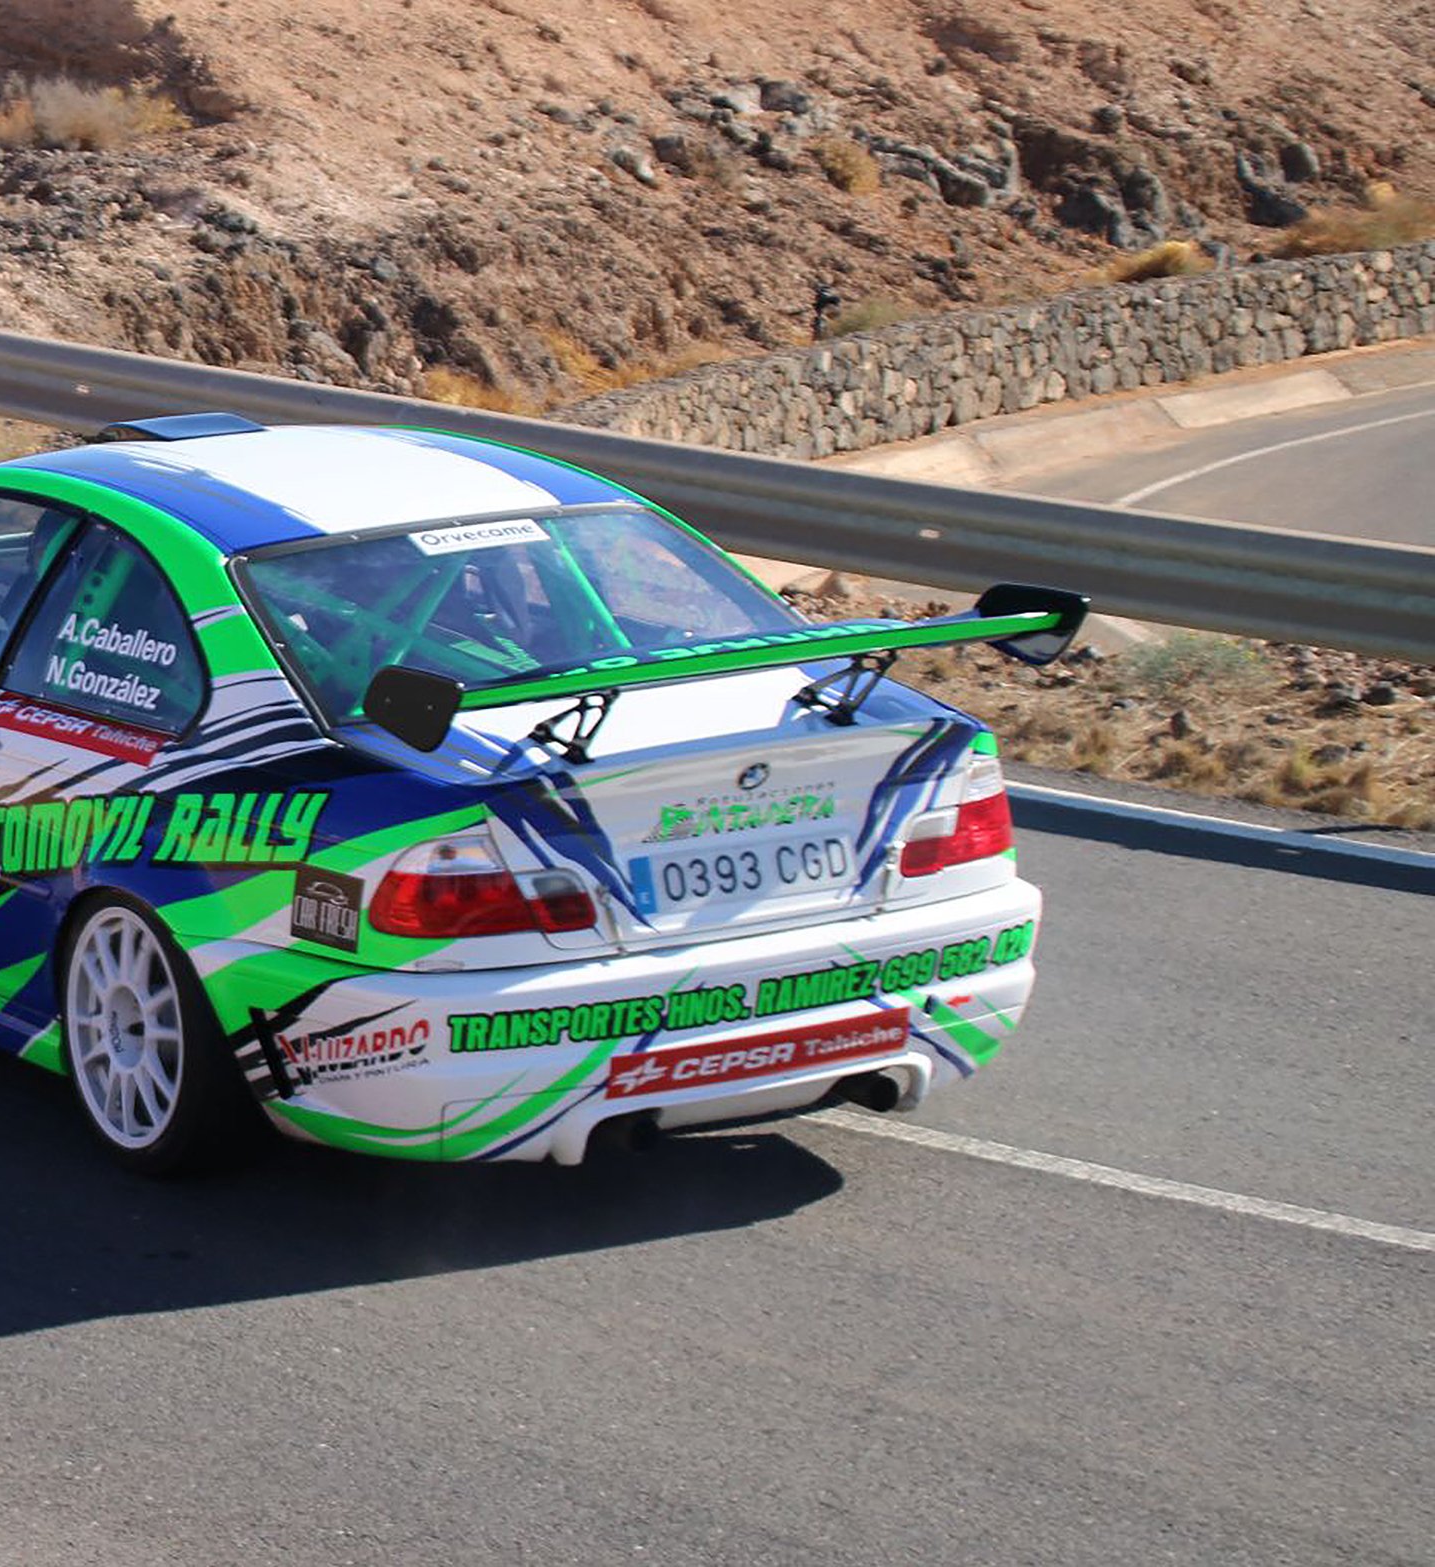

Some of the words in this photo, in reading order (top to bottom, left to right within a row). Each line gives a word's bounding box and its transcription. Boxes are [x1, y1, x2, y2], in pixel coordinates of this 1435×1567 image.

[420, 524, 534, 546] Orvecame
[58, 612, 177, 666] A.Caballero
[46, 655, 161, 710] N.González
[15, 705, 95, 734] CEPSA
[663, 851, 762, 901] 0393
[776, 838, 848, 884] CGD
[448, 997, 661, 1053] TRANSPORTES
[665, 983, 750, 1029] HNOS.
[755, 961, 880, 1019] RAMIREZ
[881, 948, 938, 993] 699
[938, 936, 990, 981] 582
[671, 1042, 797, 1081] CEPSA
[805, 1026, 904, 1057] Tahiche
